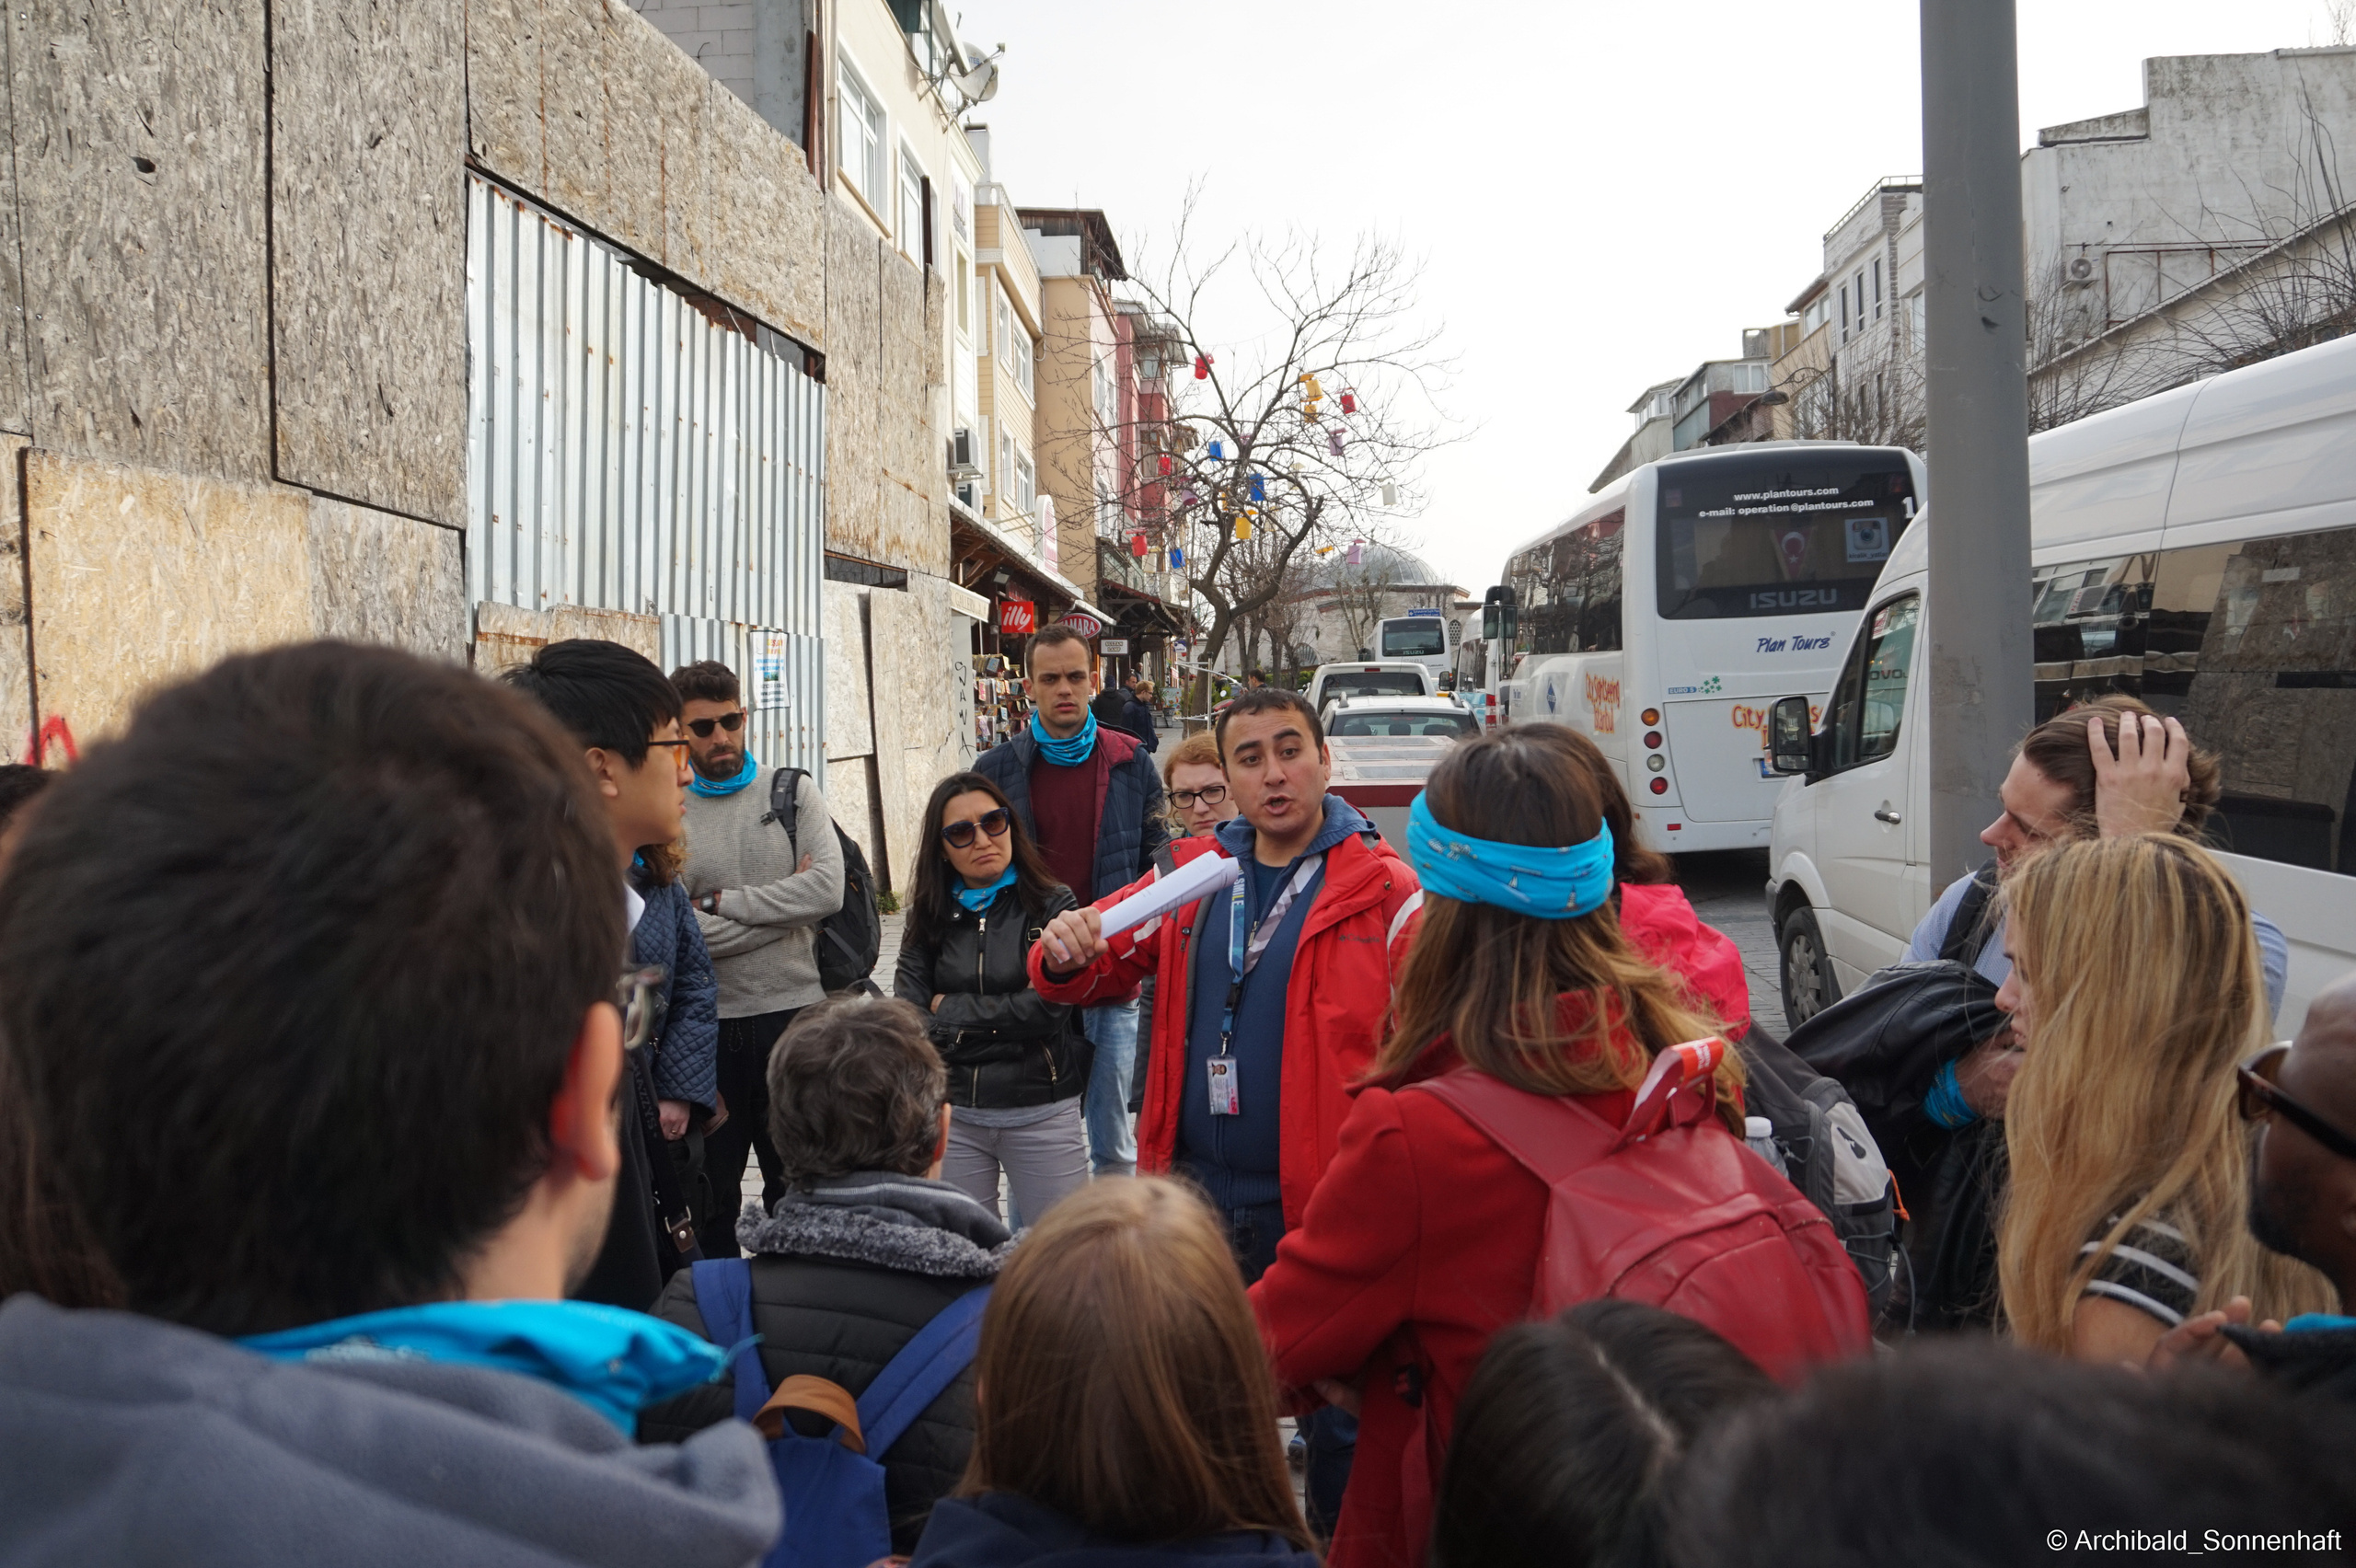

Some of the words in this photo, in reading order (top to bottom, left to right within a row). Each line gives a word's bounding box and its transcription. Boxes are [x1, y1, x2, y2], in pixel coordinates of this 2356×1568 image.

[1734, 487, 1839, 502] www.plantours.com
[1699, 507, 1736, 517] e-mail:
[1750, 588, 1837, 608] ISUZU
[1003, 605, 1031, 630] illy
[1756, 637, 1786, 652] Plan
[1791, 635, 1831, 651] Tours
[1732, 705, 1765, 730] City
